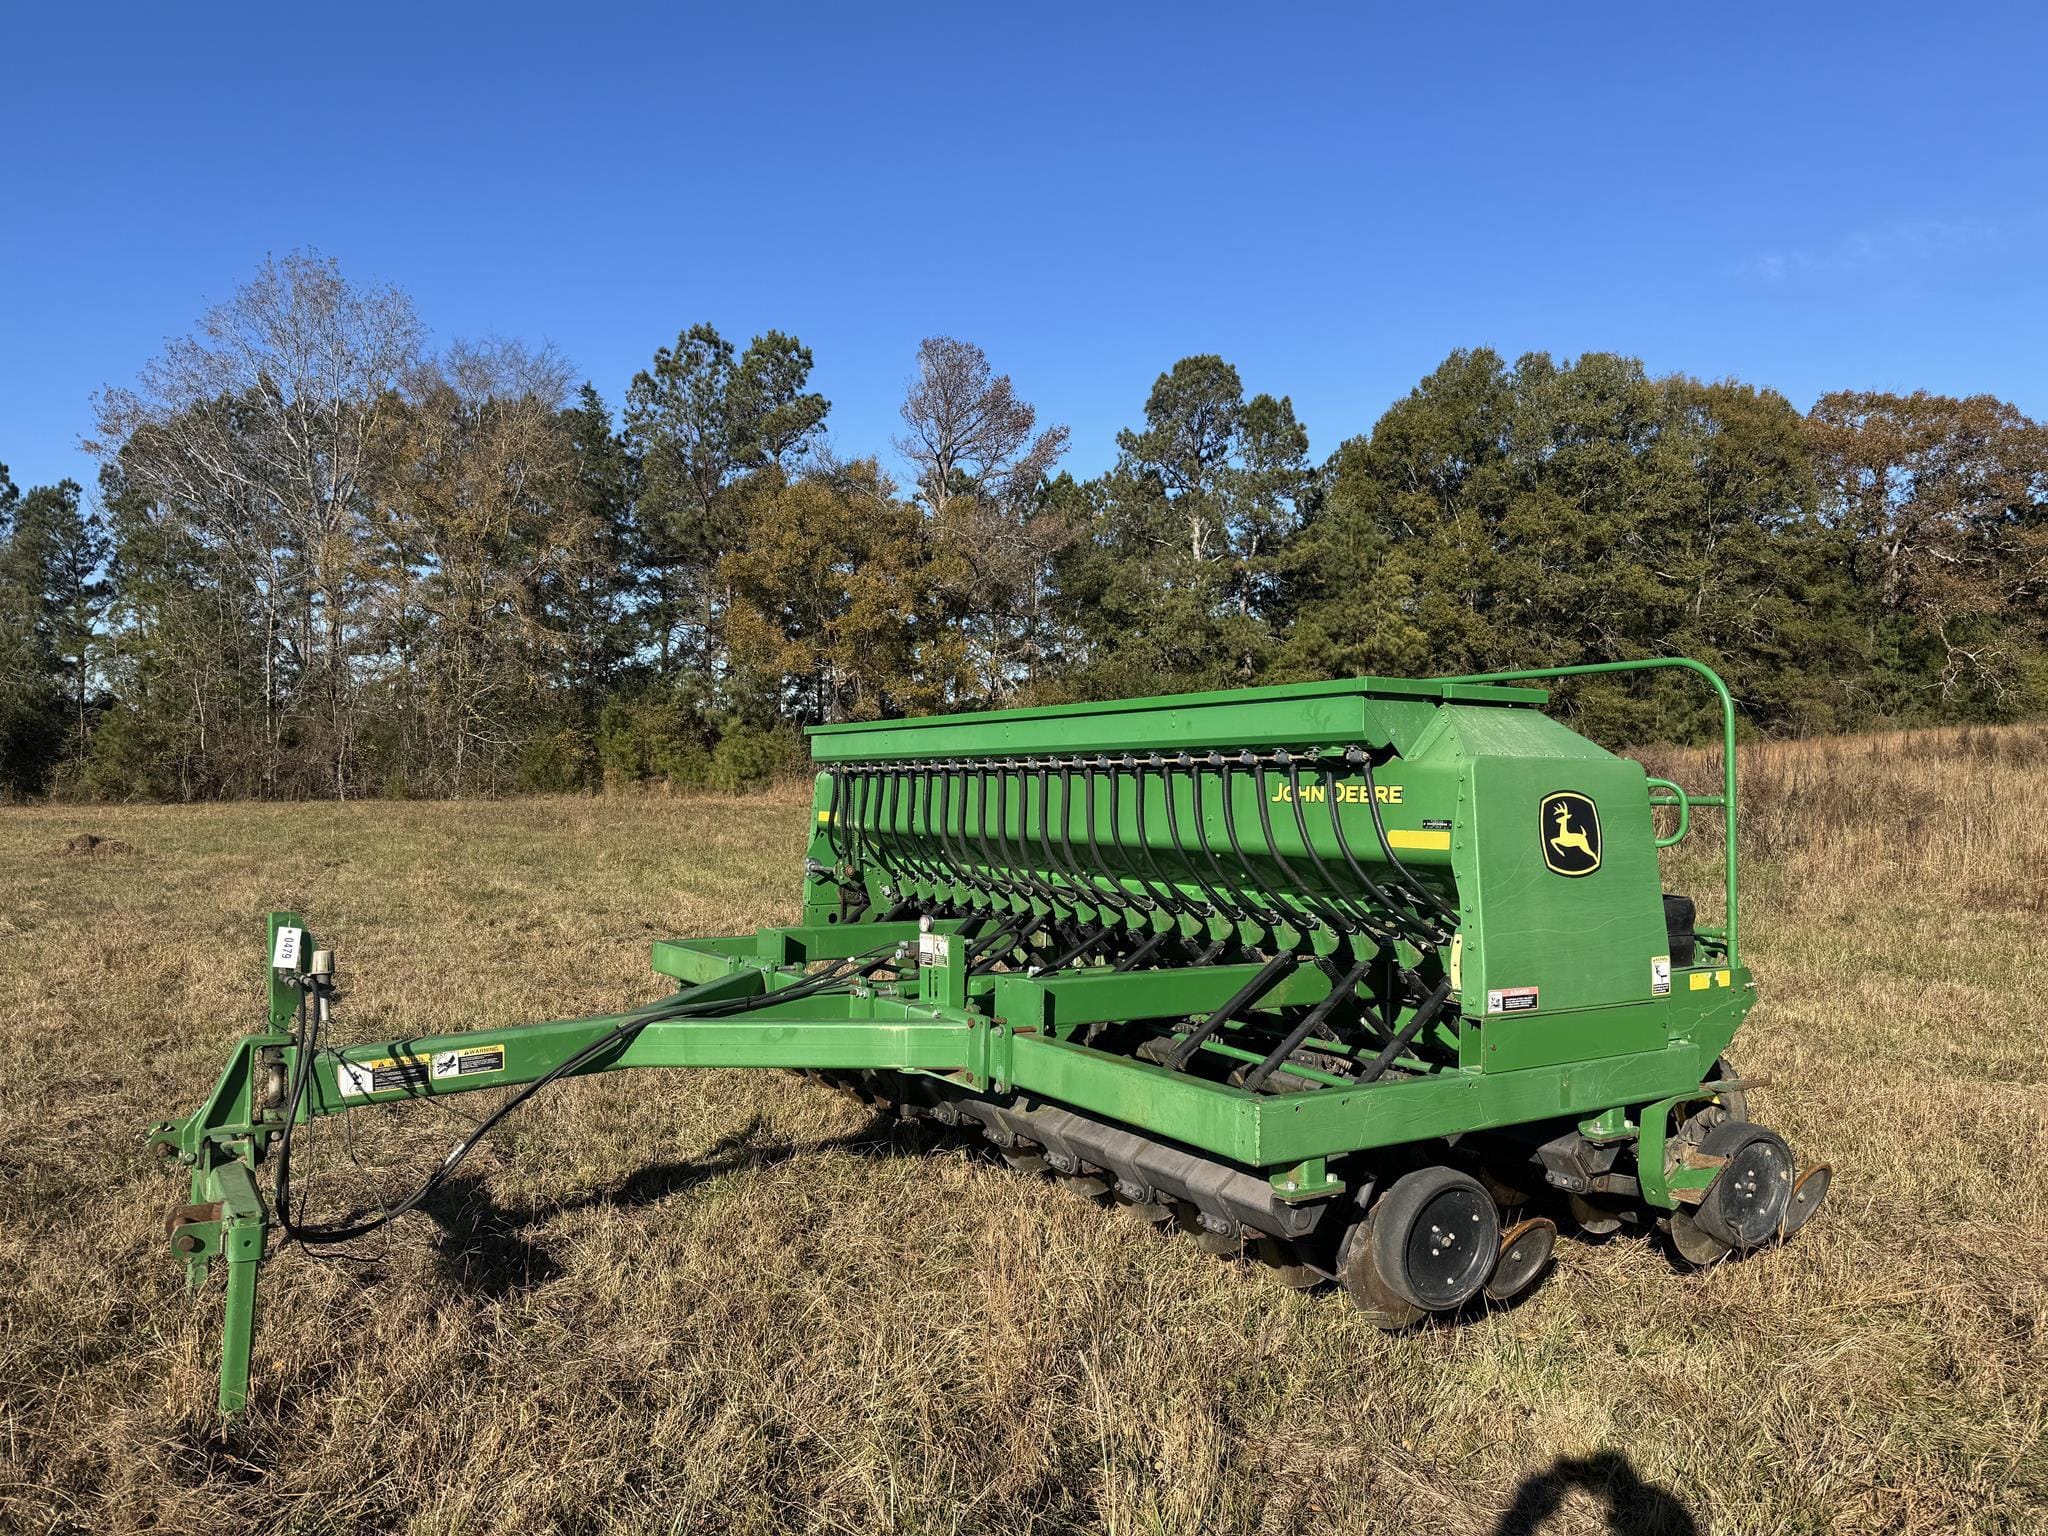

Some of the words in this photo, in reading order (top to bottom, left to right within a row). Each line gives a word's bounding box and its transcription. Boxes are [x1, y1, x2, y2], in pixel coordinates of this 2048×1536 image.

[1271, 782, 1325, 803] JOHN
[1332, 782, 1403, 803] DEERE
[281, 937, 294, 959] 0479
[468, 1046, 500, 1055] WARNING
